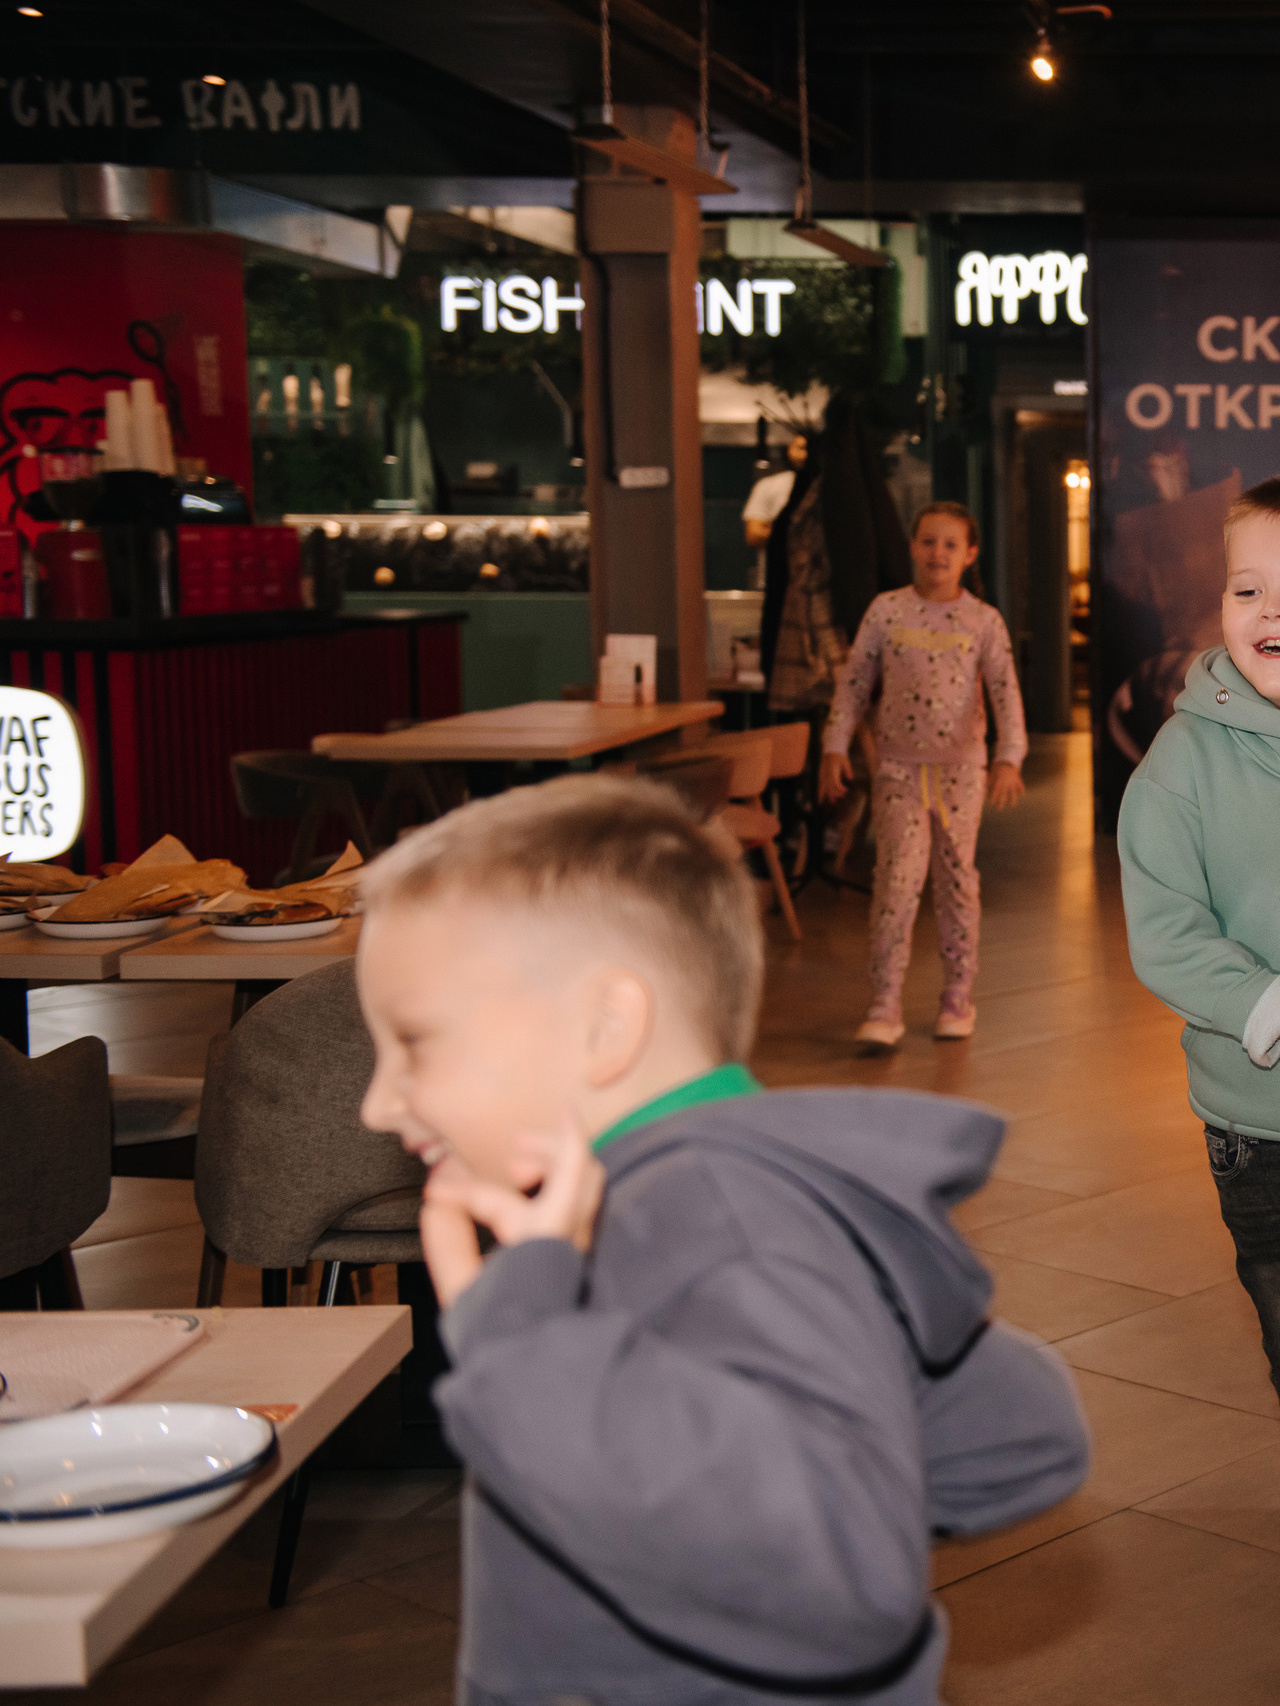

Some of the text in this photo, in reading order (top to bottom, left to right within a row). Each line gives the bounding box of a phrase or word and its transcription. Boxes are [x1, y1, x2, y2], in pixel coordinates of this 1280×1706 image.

[0, 77, 362, 132] СКИЕ ВАФЛИ
[440, 275, 585, 334] FISH
[0, 716, 51, 758] AF
[0, 762, 52, 798] US
